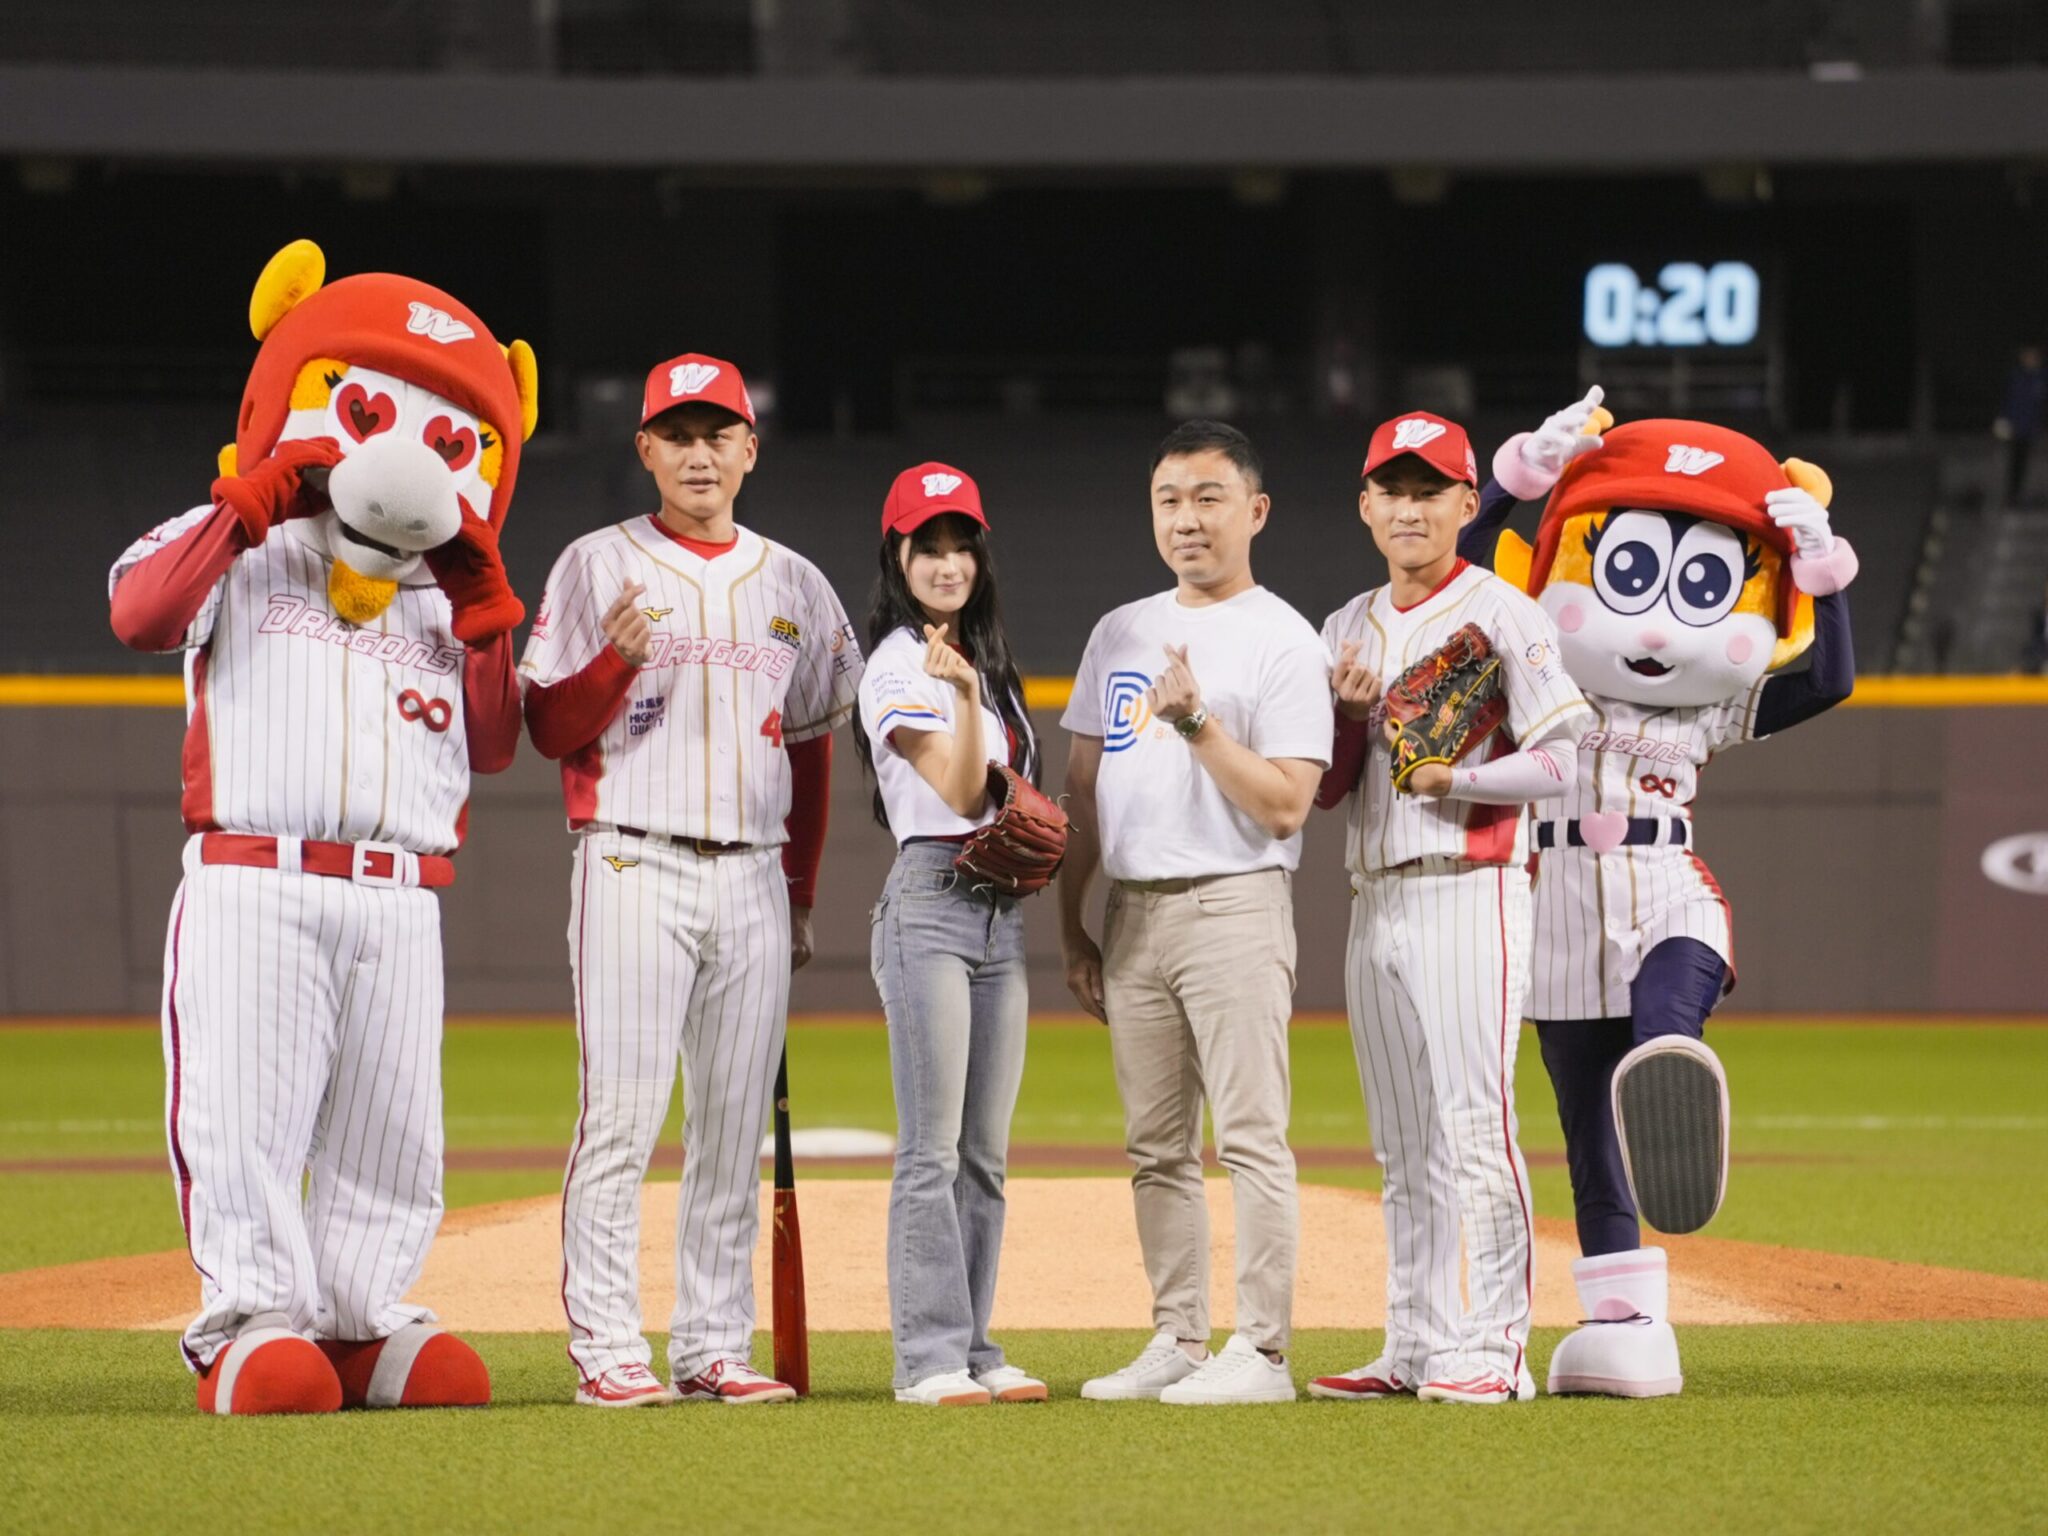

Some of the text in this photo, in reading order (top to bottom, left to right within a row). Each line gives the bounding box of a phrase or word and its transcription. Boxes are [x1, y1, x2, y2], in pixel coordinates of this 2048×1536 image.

[1583, 262, 1760, 346] 0:20
[406, 301, 476, 344] W
[669, 362, 720, 397] W
[1392, 418, 1447, 449] W
[1664, 444, 1725, 475] W
[921, 473, 962, 497] W
[258, 593, 466, 676] DRAGONS
